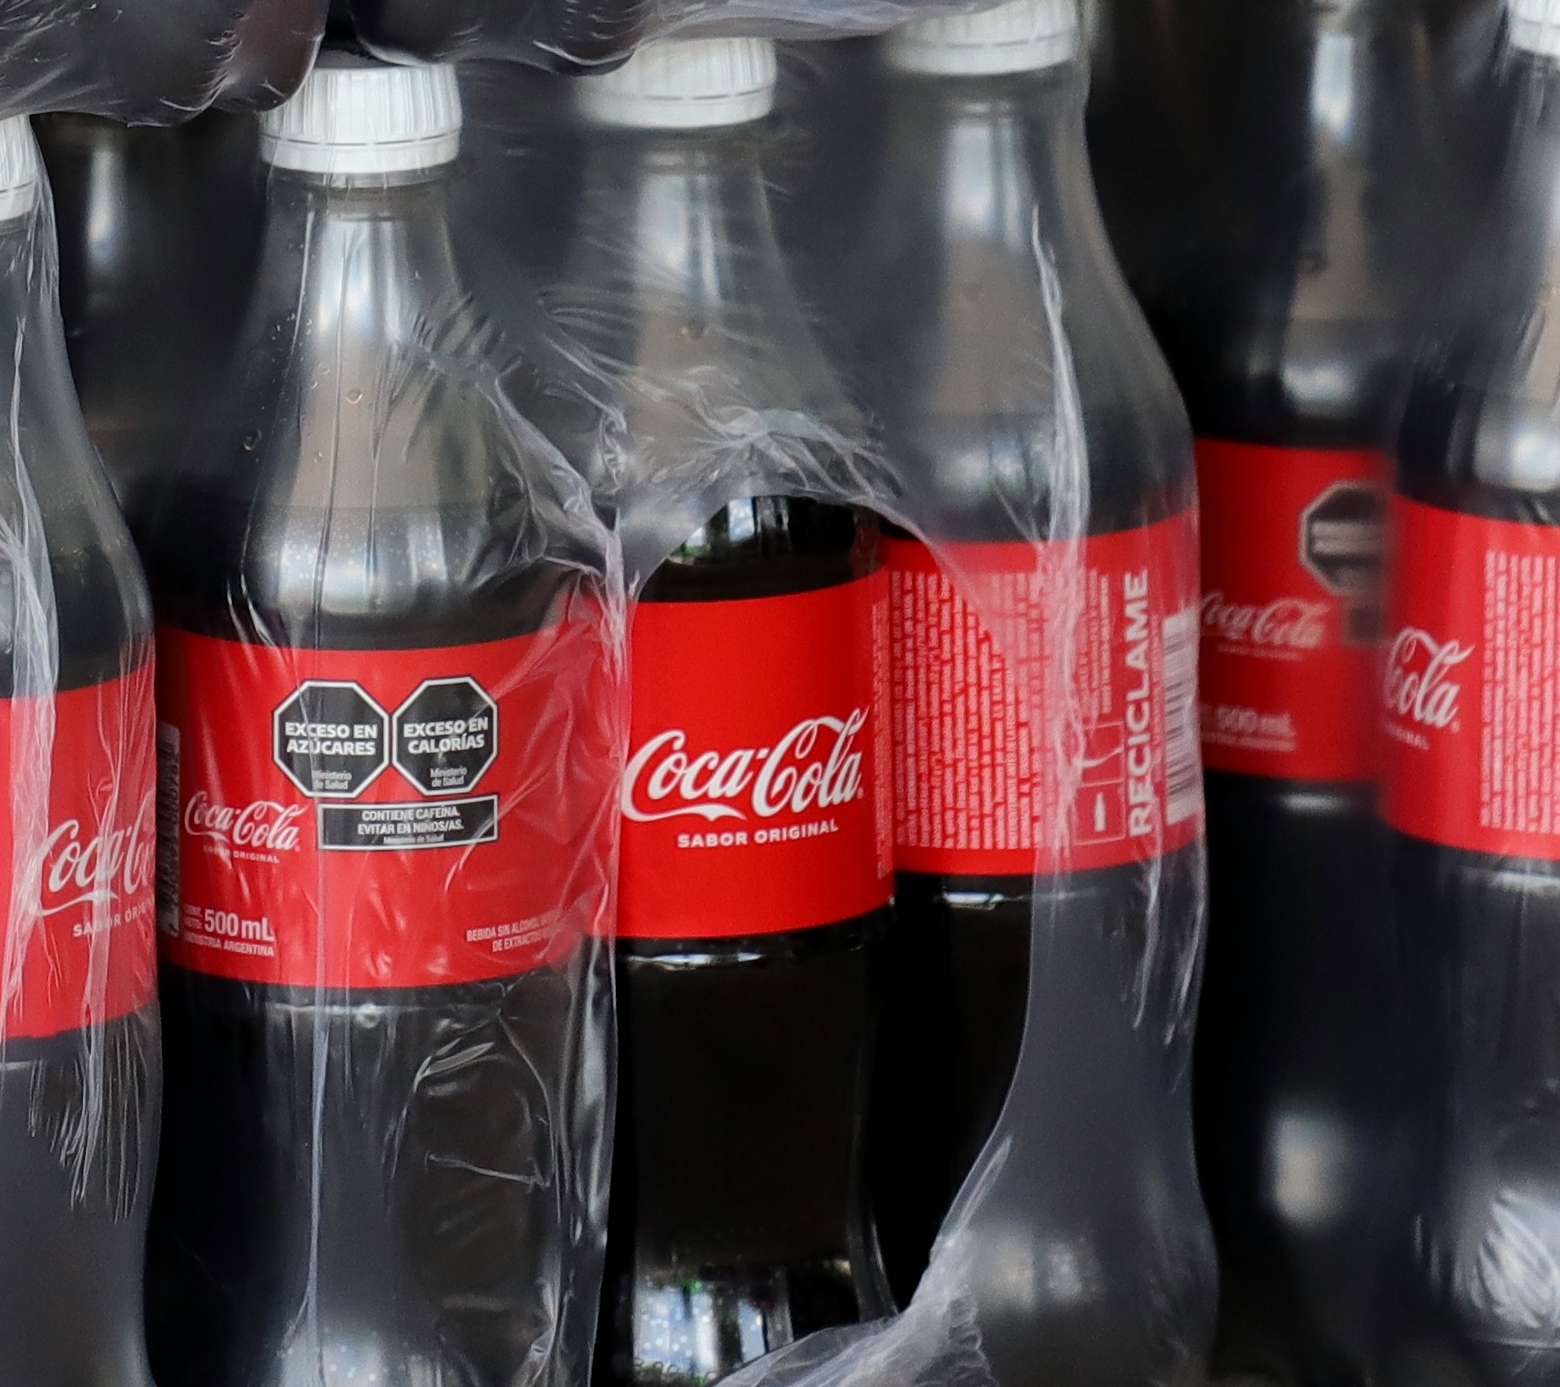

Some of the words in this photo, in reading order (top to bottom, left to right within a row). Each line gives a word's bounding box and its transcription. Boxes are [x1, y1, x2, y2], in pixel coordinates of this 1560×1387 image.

[1124, 568, 1153, 837] RECICLAME
[285, 721, 350, 738] EXCESO
[354, 723, 378, 739] EN
[403, 719, 464, 738] EXCESO
[467, 716, 489, 732] EN
[286, 737, 376, 756] AZÚCARES
[408, 733, 485, 755] CALORÍAS
[621, 705, 871, 822] Coca-Cola
[184, 790, 310, 852] Coca-Cola
[362, 809, 415, 822] CONTIENE
[416, 805, 461, 819] CAFEÍNA.
[358, 823, 395, 835] EVITAR
[396, 823, 412, 834] EN
[677, 829, 749, 849] SABOR
[754, 818, 840, 844] ORIGINAL
[233, 850, 280, 864] ORIGINAL
[223, 938, 276, 957] ARGENTINA
